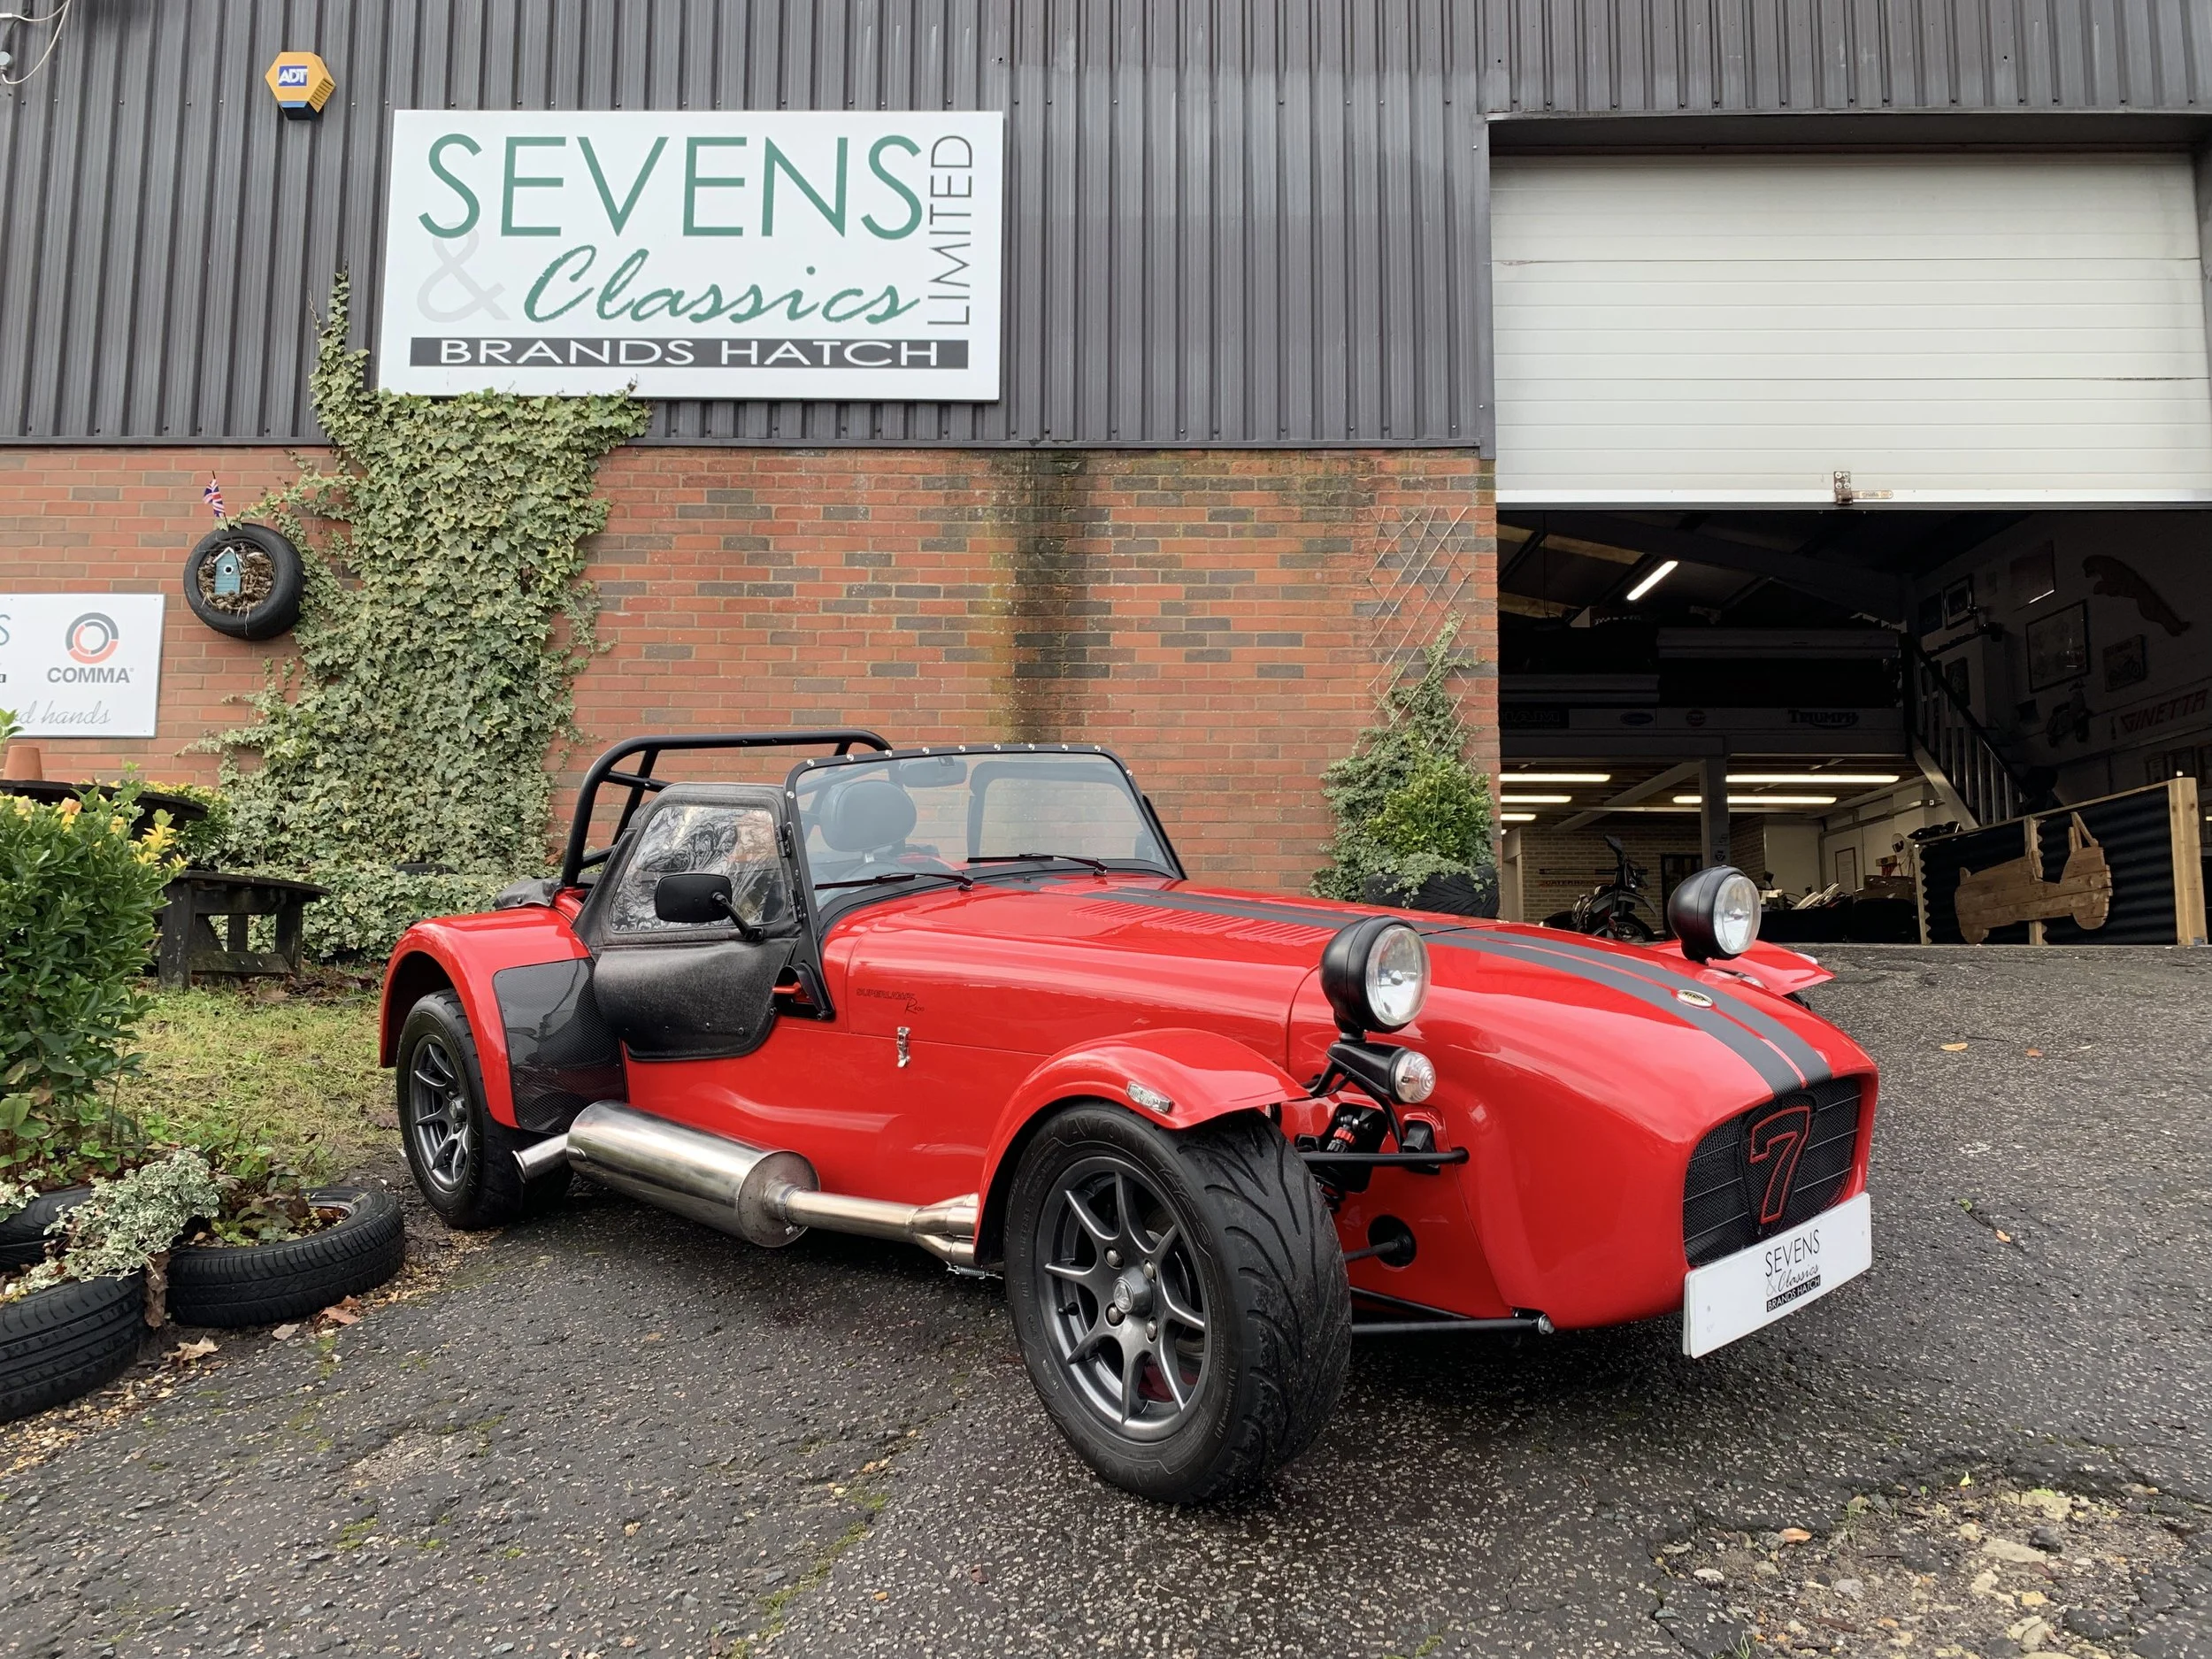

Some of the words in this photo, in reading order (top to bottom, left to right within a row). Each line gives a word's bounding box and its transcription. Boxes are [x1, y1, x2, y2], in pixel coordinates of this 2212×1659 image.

[279, 68, 308, 84] ADT
[418, 133, 923, 240] SEVENS
[927, 134, 973, 326] LIMITED
[416, 221, 511, 323] &
[525, 244, 921, 324] Classics
[441, 340, 695, 365] BRANDS
[720, 341, 939, 366] HATCH
[47, 667, 131, 683] COMMA
[41, 700, 111, 725] hands
[2120, 688, 2208, 733] GINETTA
[1749, 1105, 1811, 1225] 7
[1765, 1229, 1820, 1277] SEVENS
[1767, 1289, 1796, 1311] BRANDS
[1797, 1277, 1821, 1297] HATCH
[1778, 1263, 1819, 1292] Classics
